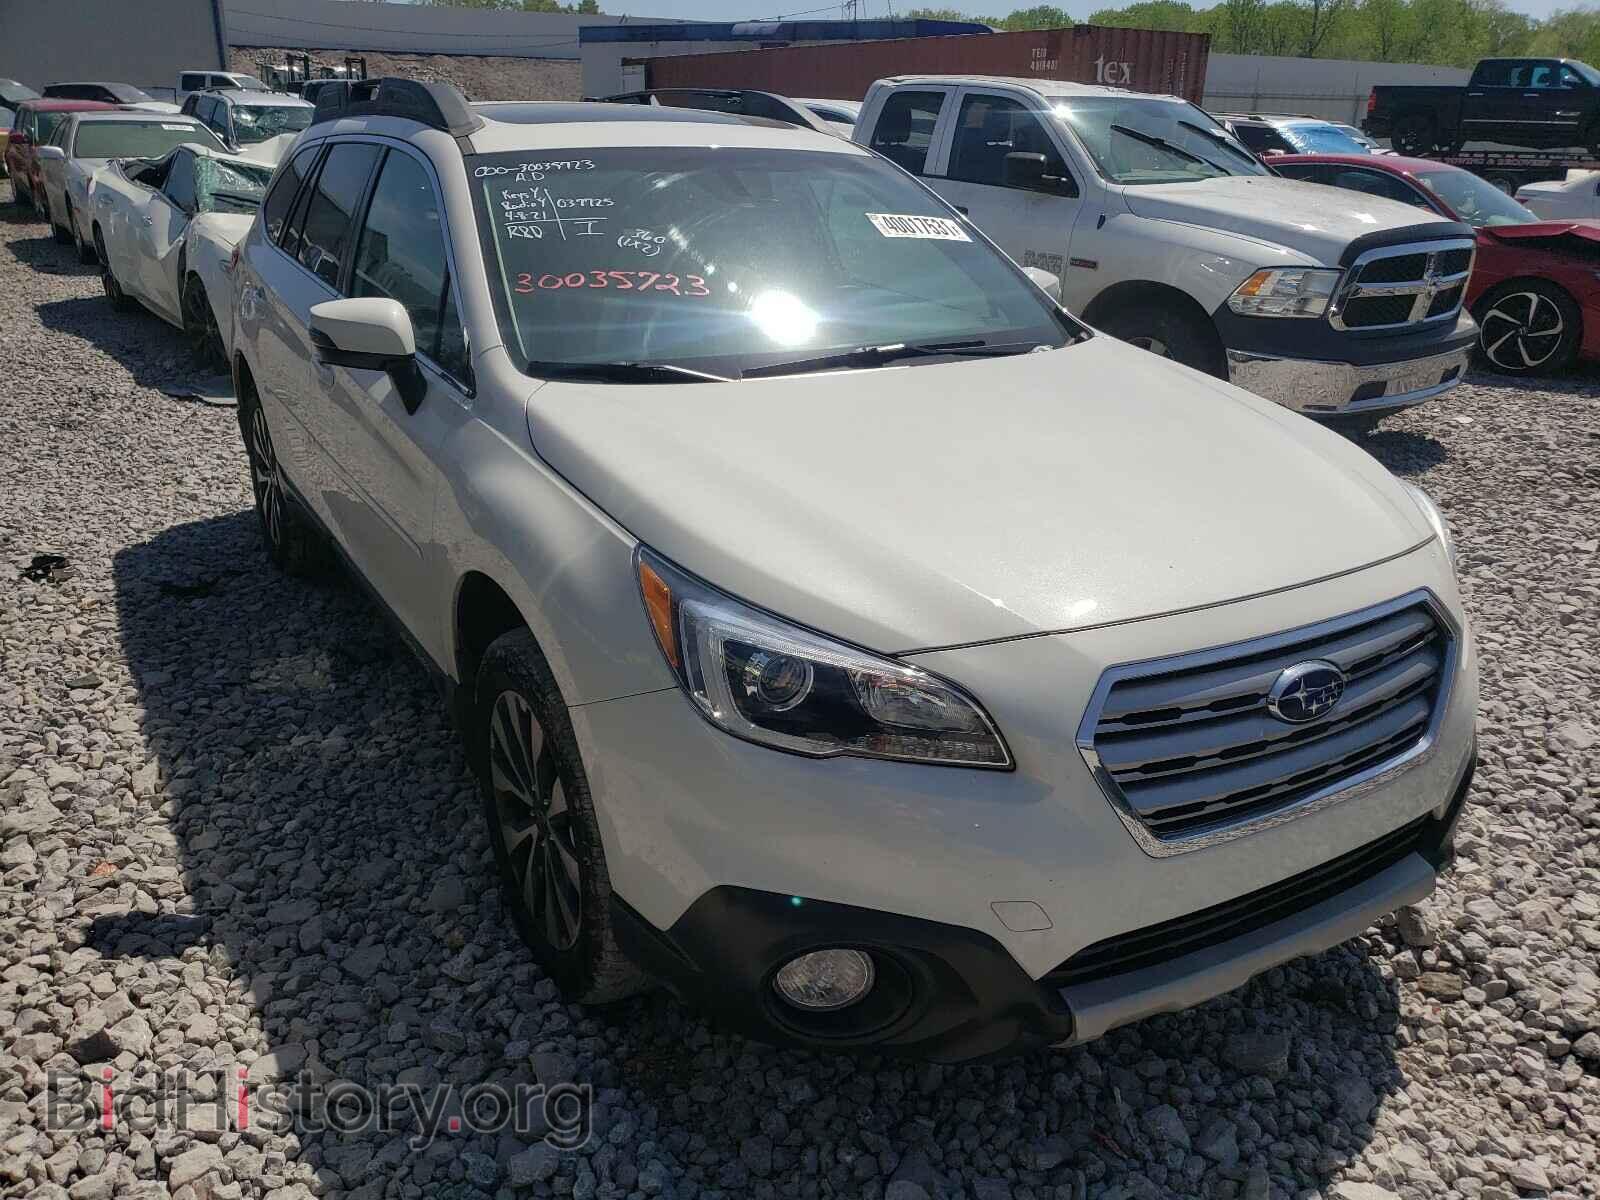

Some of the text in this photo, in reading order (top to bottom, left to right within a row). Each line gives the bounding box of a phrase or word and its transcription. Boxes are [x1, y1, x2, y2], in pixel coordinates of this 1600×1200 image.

[1095, 53, 1132, 84] tex
[501, 187, 540, 202] Keys Y
[501, 198, 537, 210] Radio
[515, 270, 711, 296] 30035723
